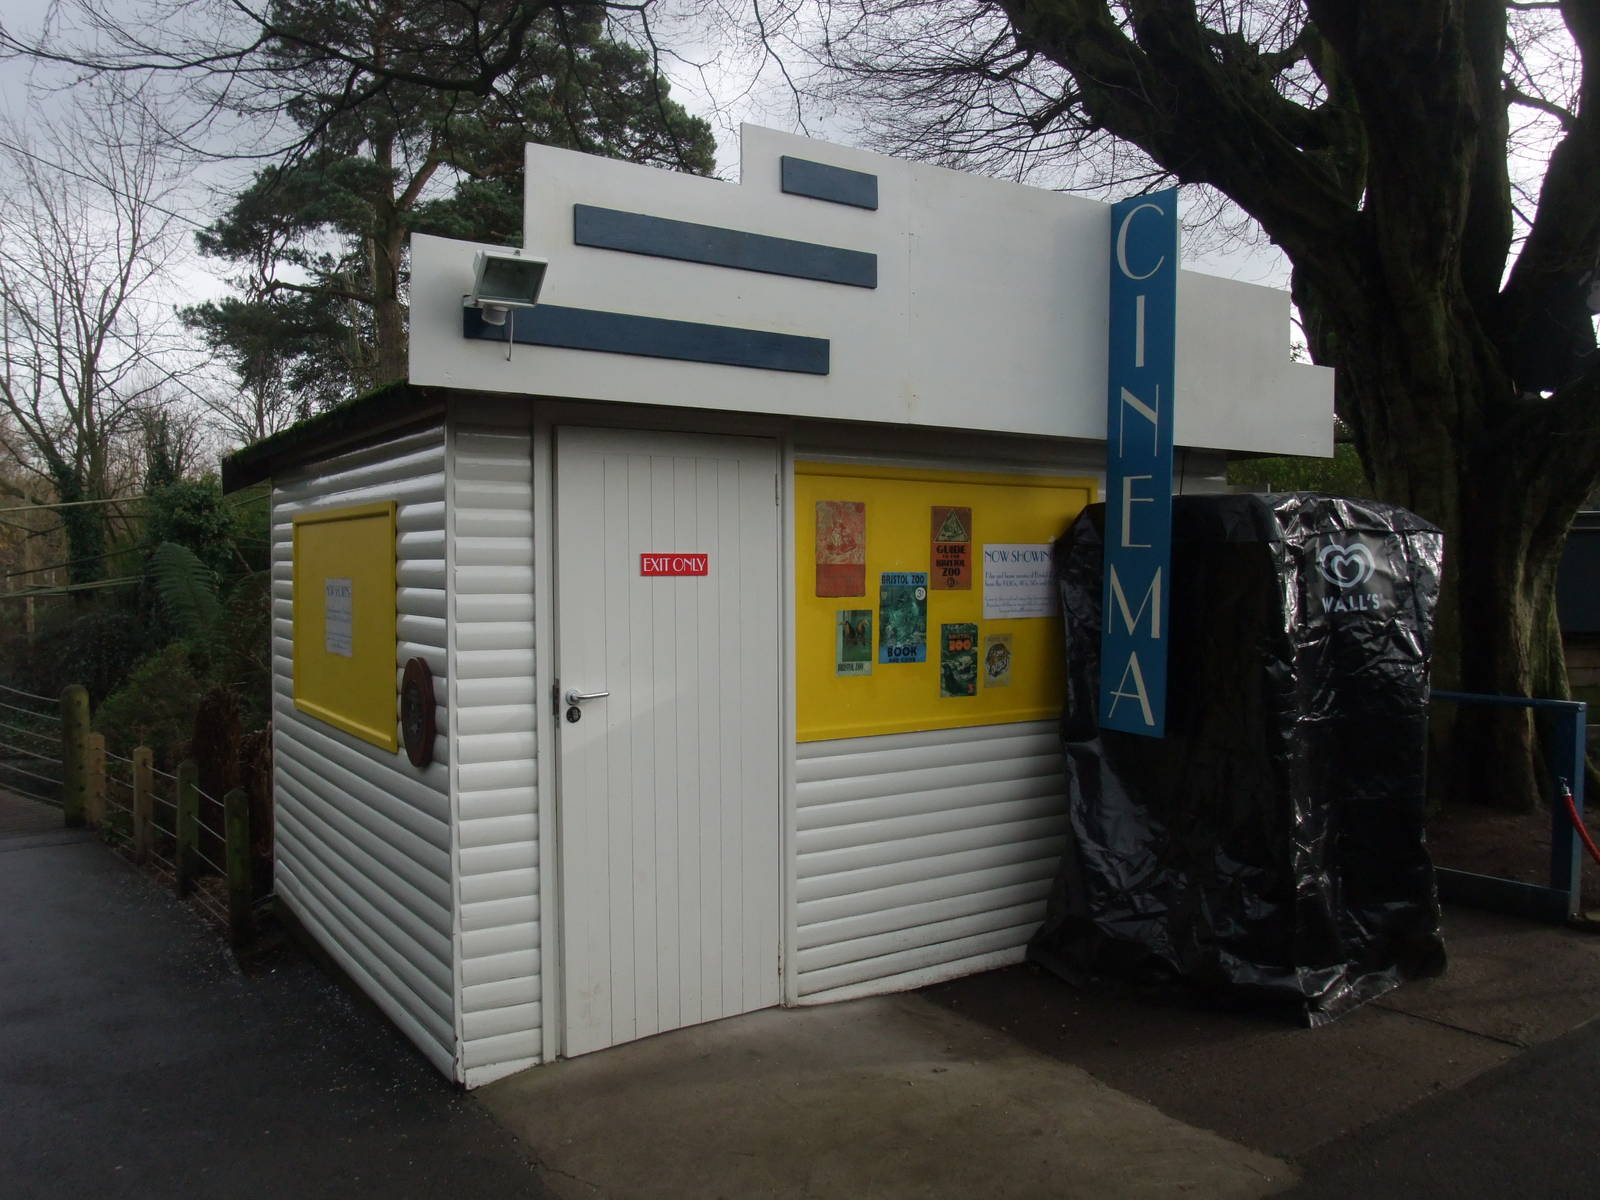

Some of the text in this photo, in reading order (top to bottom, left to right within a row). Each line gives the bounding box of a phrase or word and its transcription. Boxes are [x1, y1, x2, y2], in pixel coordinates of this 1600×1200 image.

[1107, 202, 1166, 728] CINEMA
[984, 550, 1055, 563] NOW SHOWIN
[643, 557, 706, 572] EXIT ONLY
[942, 567, 961, 577] ZOO
[881, 574, 925, 585] BRISTOL ZOO
[1321, 593, 1381, 614] WALL'S
[887, 646, 917, 658] BOOK
